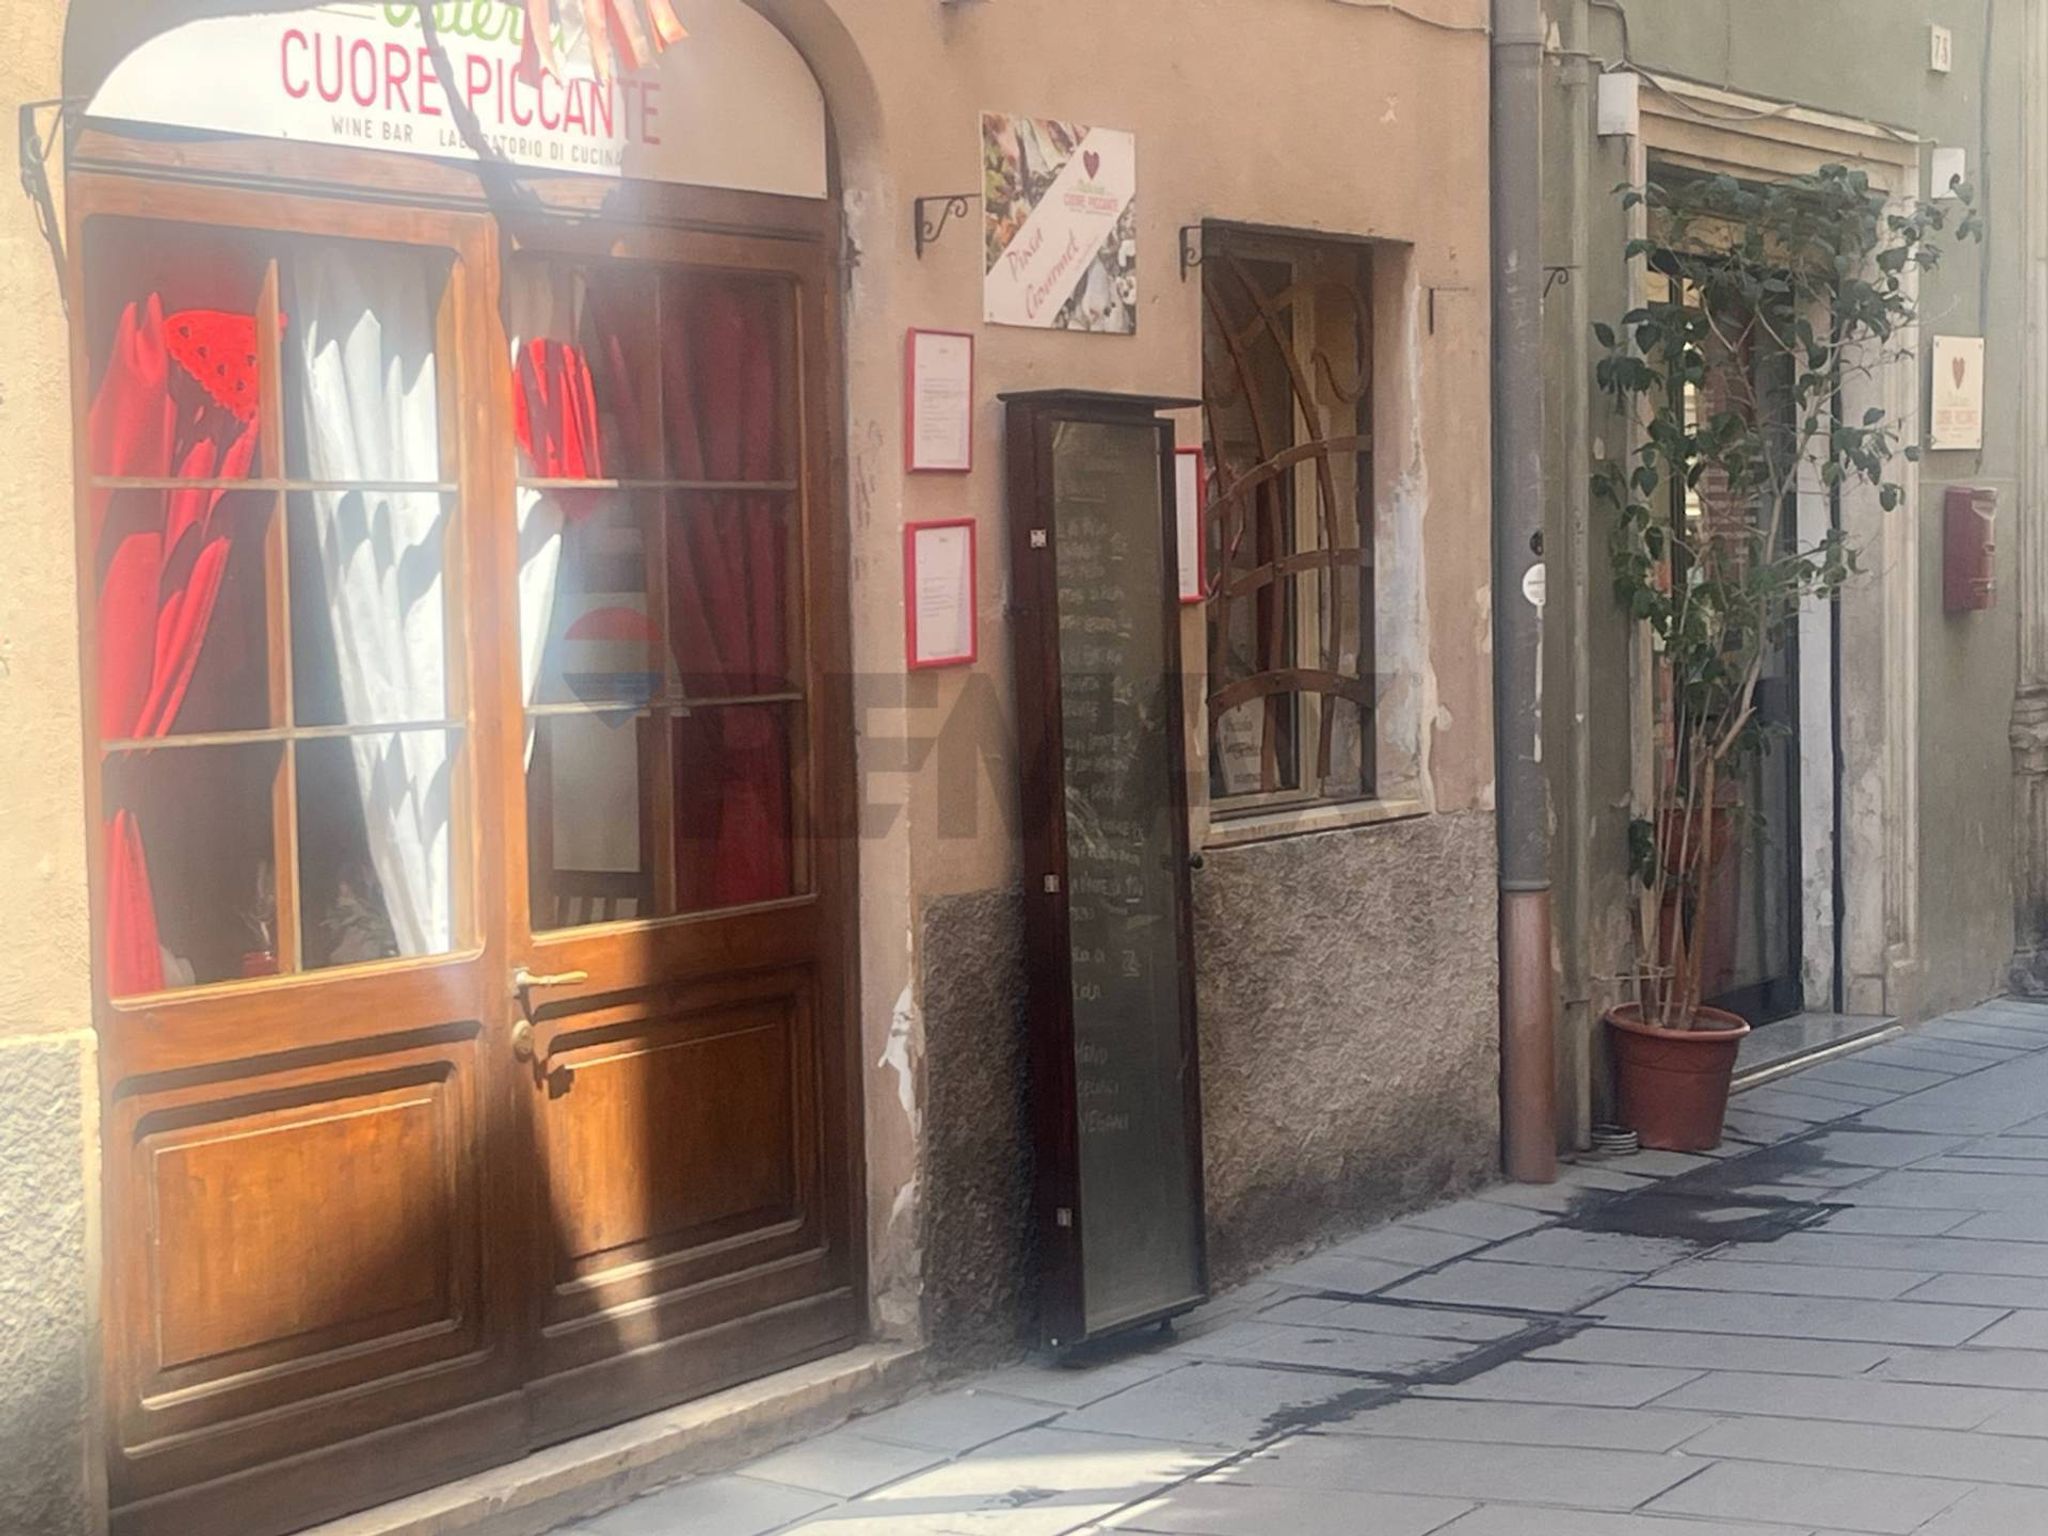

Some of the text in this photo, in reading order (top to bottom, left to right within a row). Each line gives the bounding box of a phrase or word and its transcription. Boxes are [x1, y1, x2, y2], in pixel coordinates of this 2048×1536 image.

[281, 29, 661, 145] CUORE PICCANTE
[332, 116, 374, 139] WINE
[382, 121, 414, 143] BAR
[440, 129, 542, 158] LARATORIO
[551, 142, 564, 161] DI
